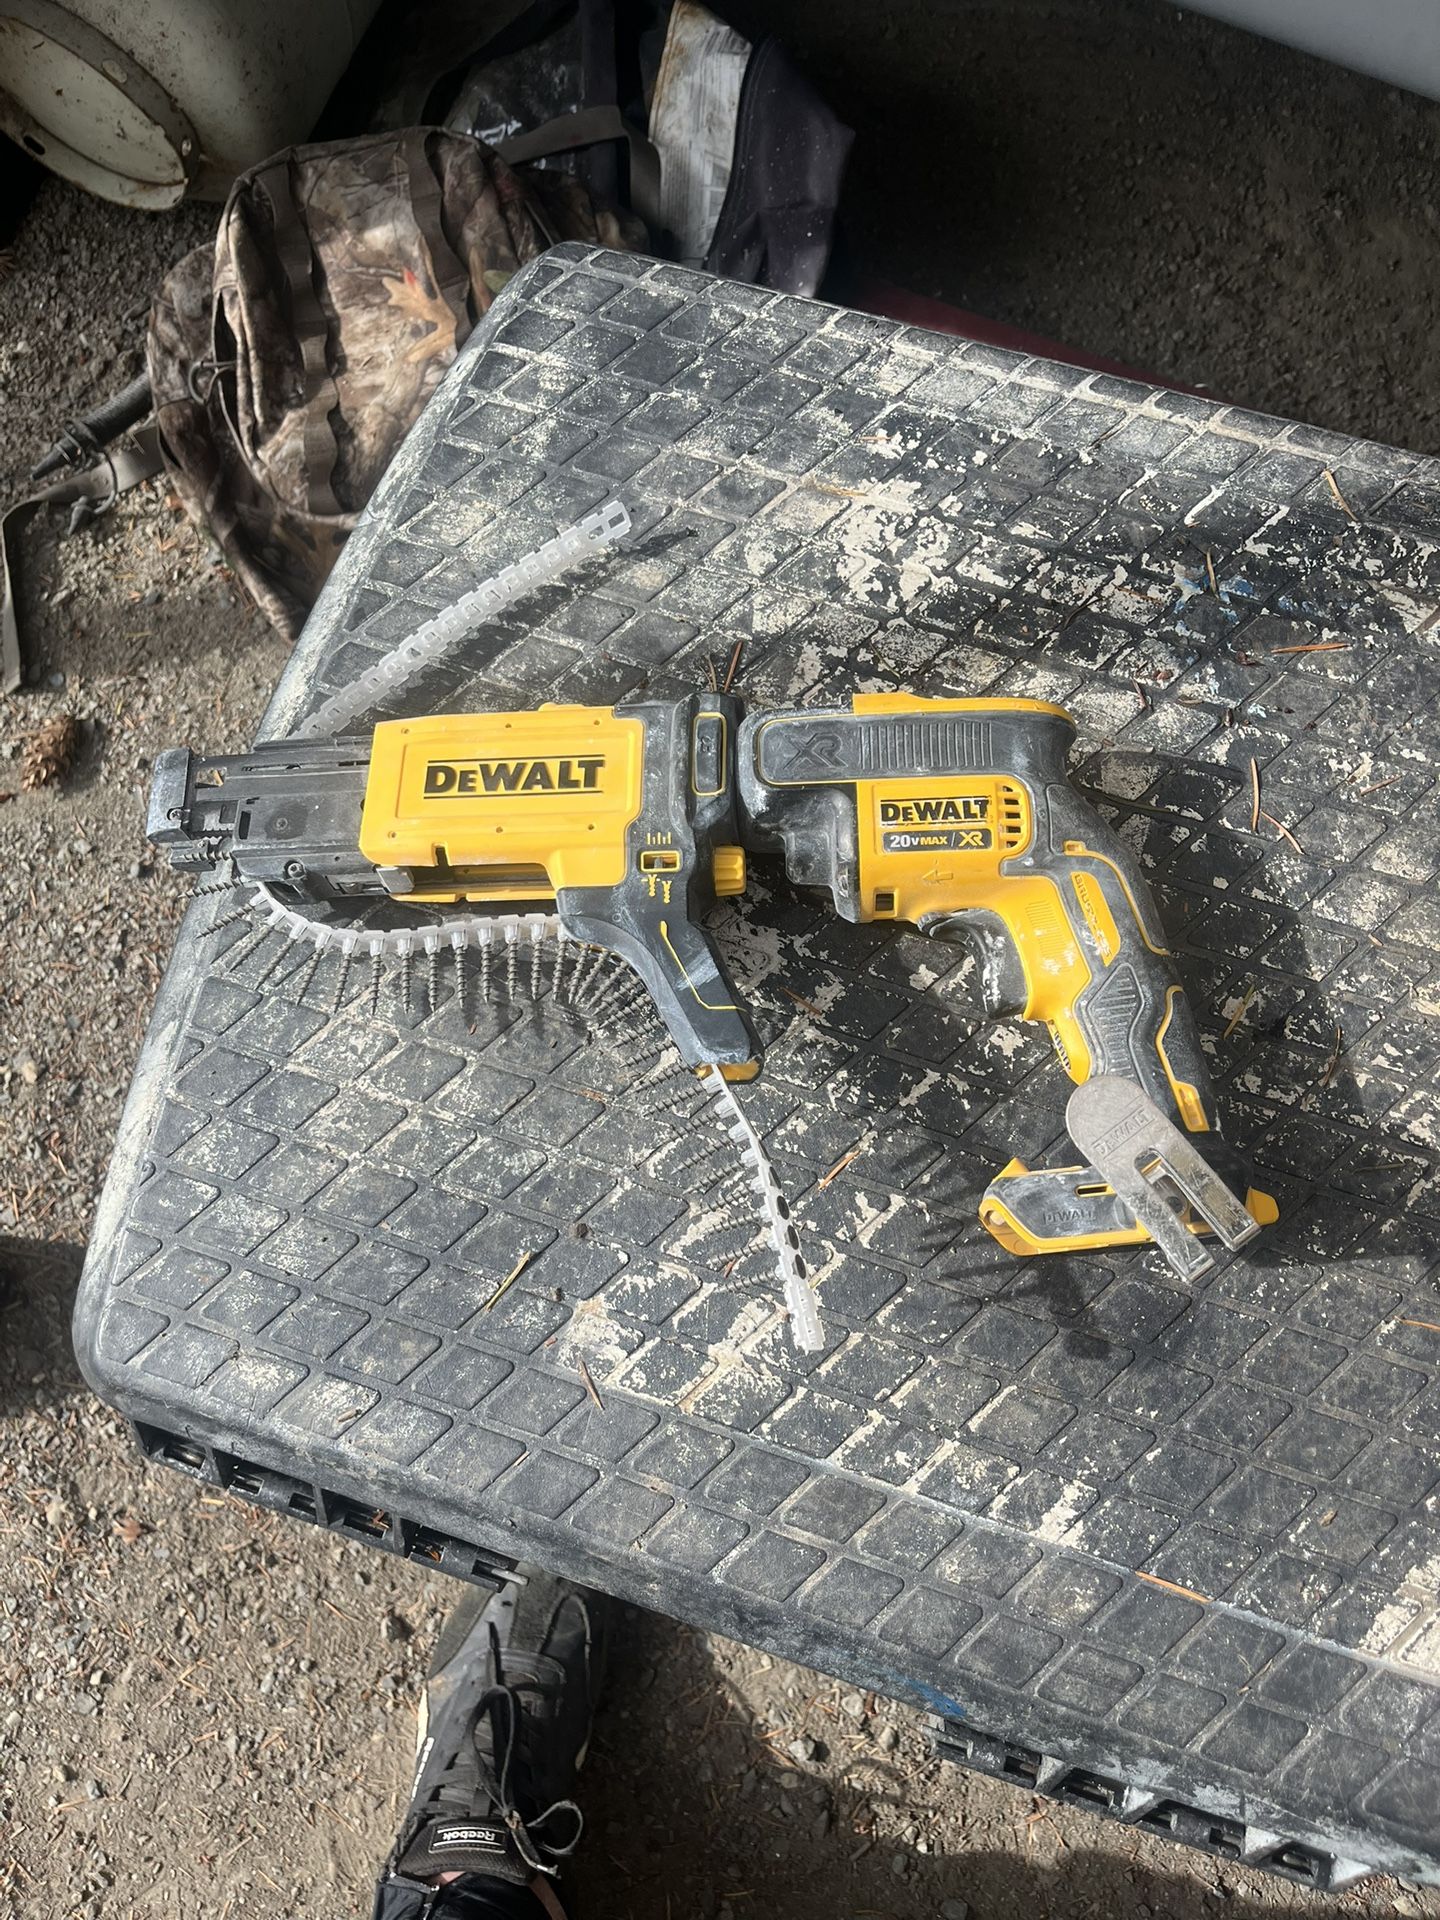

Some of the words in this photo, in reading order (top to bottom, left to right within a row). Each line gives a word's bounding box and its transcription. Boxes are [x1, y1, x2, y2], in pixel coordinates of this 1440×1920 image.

[958, 831, 985, 847] XR
[1075, 874, 1113, 958] BRUSESS
[442, 1830, 496, 1841] Reebok
